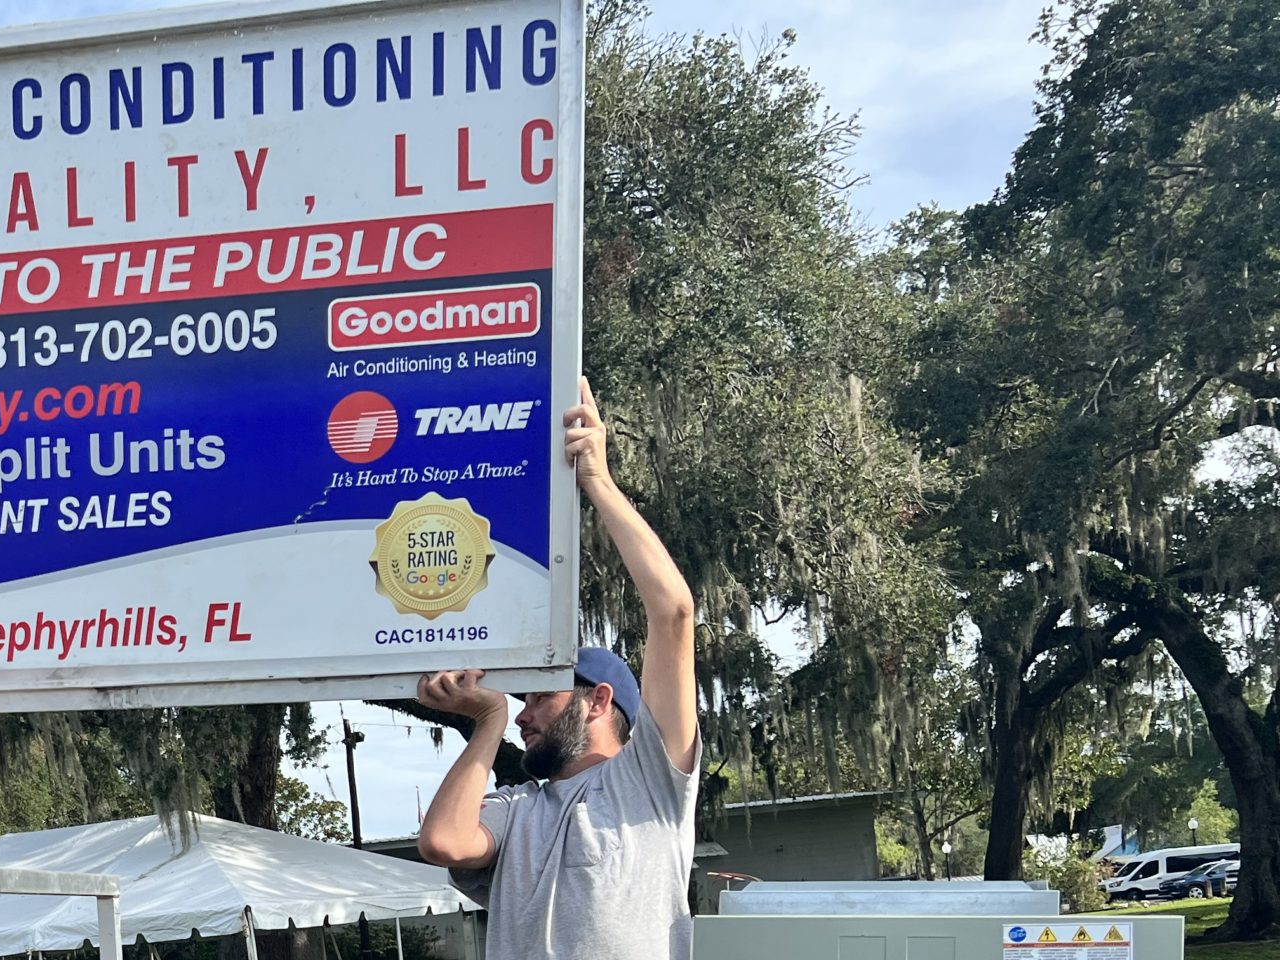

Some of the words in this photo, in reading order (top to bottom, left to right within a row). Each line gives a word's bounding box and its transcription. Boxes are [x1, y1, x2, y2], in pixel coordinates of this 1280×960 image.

[11, 18, 558, 141] CONDITIONING
[394, 118, 554, 197] LLC
[82, 244, 195, 297] THE
[212, 221, 448, 288] PUBLIC
[337, 296, 531, 337] Goodman
[327, 358, 349, 378] Air
[353, 353, 451, 379] Conditioning
[457, 351, 469, 368] &
[474, 347, 538, 374] Heating
[414, 400, 534, 436] TRANE
[89, 428, 225, 478] Units
[356, 469, 397, 486] Hard
[400, 468, 419, 484] To
[422, 466, 458, 484] Stop
[461, 465, 476, 480] A
[57, 490, 172, 533] SALES
[407, 530, 455, 549] 5-STAR
[406, 570, 457, 586] Google
[407, 550, 458, 568] RATING
[204, 602, 252, 643] FL
[375, 626, 488, 645] CAC1814196
